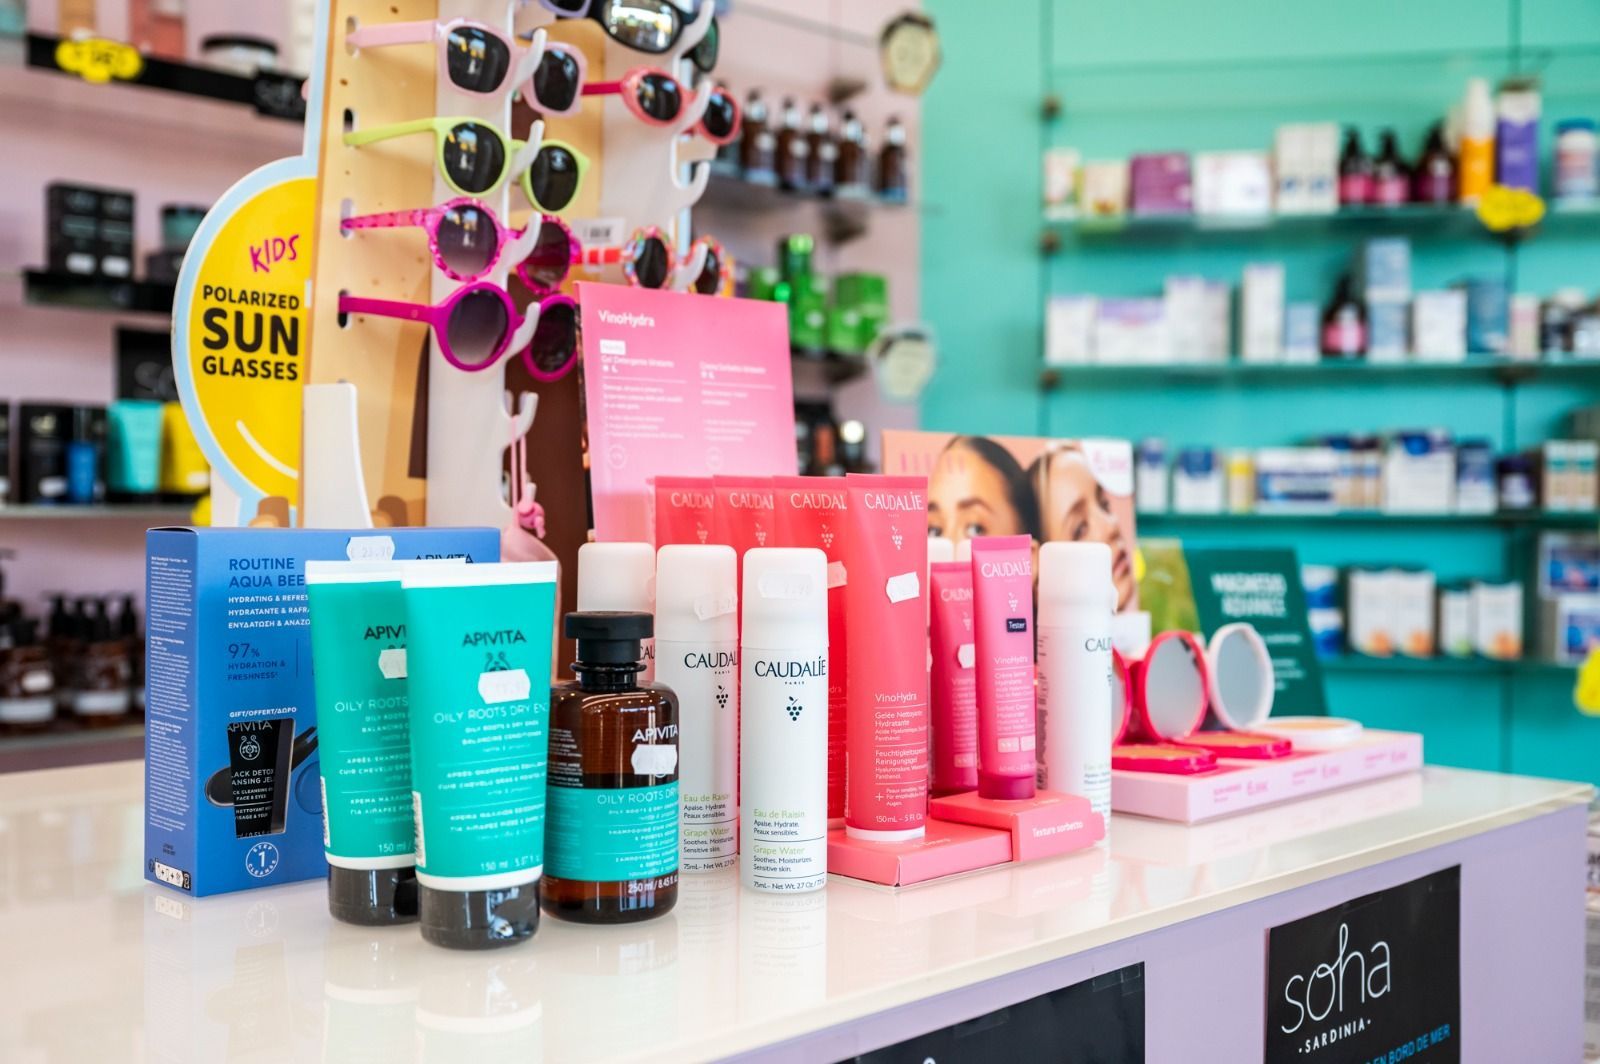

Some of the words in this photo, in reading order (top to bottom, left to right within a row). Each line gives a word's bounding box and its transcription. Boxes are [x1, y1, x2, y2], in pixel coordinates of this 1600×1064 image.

[250, 234, 299, 273] KIDS
[203, 284, 299, 311] POLARIZED
[598, 310, 654, 327] VinoHydra
[202, 307, 299, 356] SUN
[202, 355, 298, 381] GLASSES
[229, 558, 295, 570] ROUTINE
[228, 575, 272, 588] AQUA
[278, 575, 305, 586] BEE
[228, 608, 279, 616] HYDRATANTE
[1009, 621, 1025, 629] Tester
[463, 630, 527, 646] APIVITA
[228, 643, 260, 659] 97%
[228, 661, 277, 670] HYDRATION
[335, 701, 364, 712] OILY
[368, 697, 408, 709] ROOTS
[875, 693, 916, 703] VinoHydra
[434, 712, 464, 724] OILY
[467, 707, 507, 720] ROOTS
[228, 720, 272, 732] APIVITA
[875, 719, 910, 728] Hydratante
[632, 724, 679, 743] APIVITA
[232, 770, 251, 778] ACK
[597, 794, 624, 805] OILY
[629, 790, 664, 804] ROOTS
[684, 794, 698, 802] Eau
[754, 809, 766, 817] Eau
[769, 809, 780, 818] de
[781, 810, 805, 818] Raisin
[684, 829, 707, 838] Grape
[710, 827, 730, 836] Water
[1033, 823, 1057, 838] Texture
[253, 843, 272, 852] STEP
[378, 843, 394, 853] 150
[754, 845, 777, 855] Grape
[779, 847, 805, 855] Water
[258, 851, 265, 868] 1
[247, 859, 277, 876] CLEANSE
[754, 864, 777, 872] Sensitive
[628, 880, 642, 894] 250
[1281, 923, 1391, 1034] soha
[1388, 1039, 1415, 1064] BORD
[1416, 1034, 1430, 1050] DE
[1430, 1023, 1451, 1045] MER
